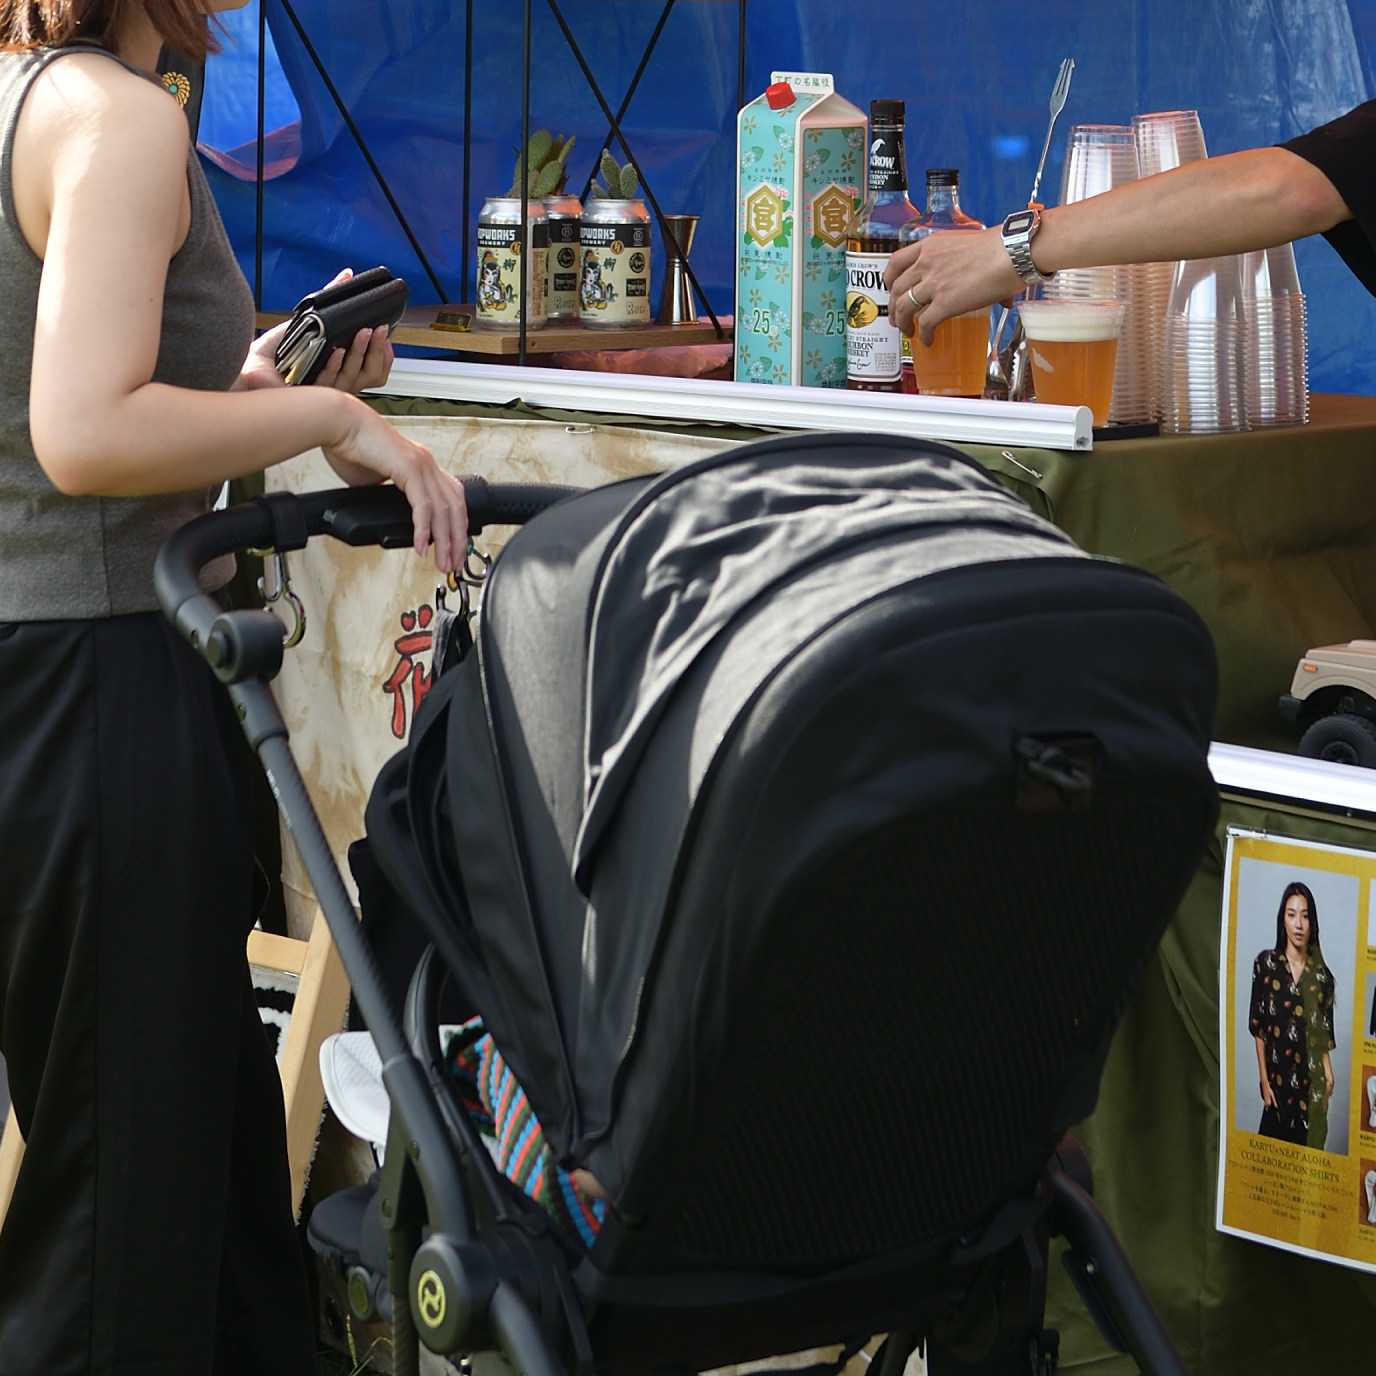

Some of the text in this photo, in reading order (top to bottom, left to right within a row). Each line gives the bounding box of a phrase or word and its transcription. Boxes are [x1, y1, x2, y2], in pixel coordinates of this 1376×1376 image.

[752, 309, 771, 334] 25
[826, 310, 845, 336] 25
[1241, 1151, 1308, 1175] COLLABORATION
[1309, 1169, 1340, 1184] SHIRTS
[1249, 1139, 1332, 1169] KARYU×NEAT ALOHA
